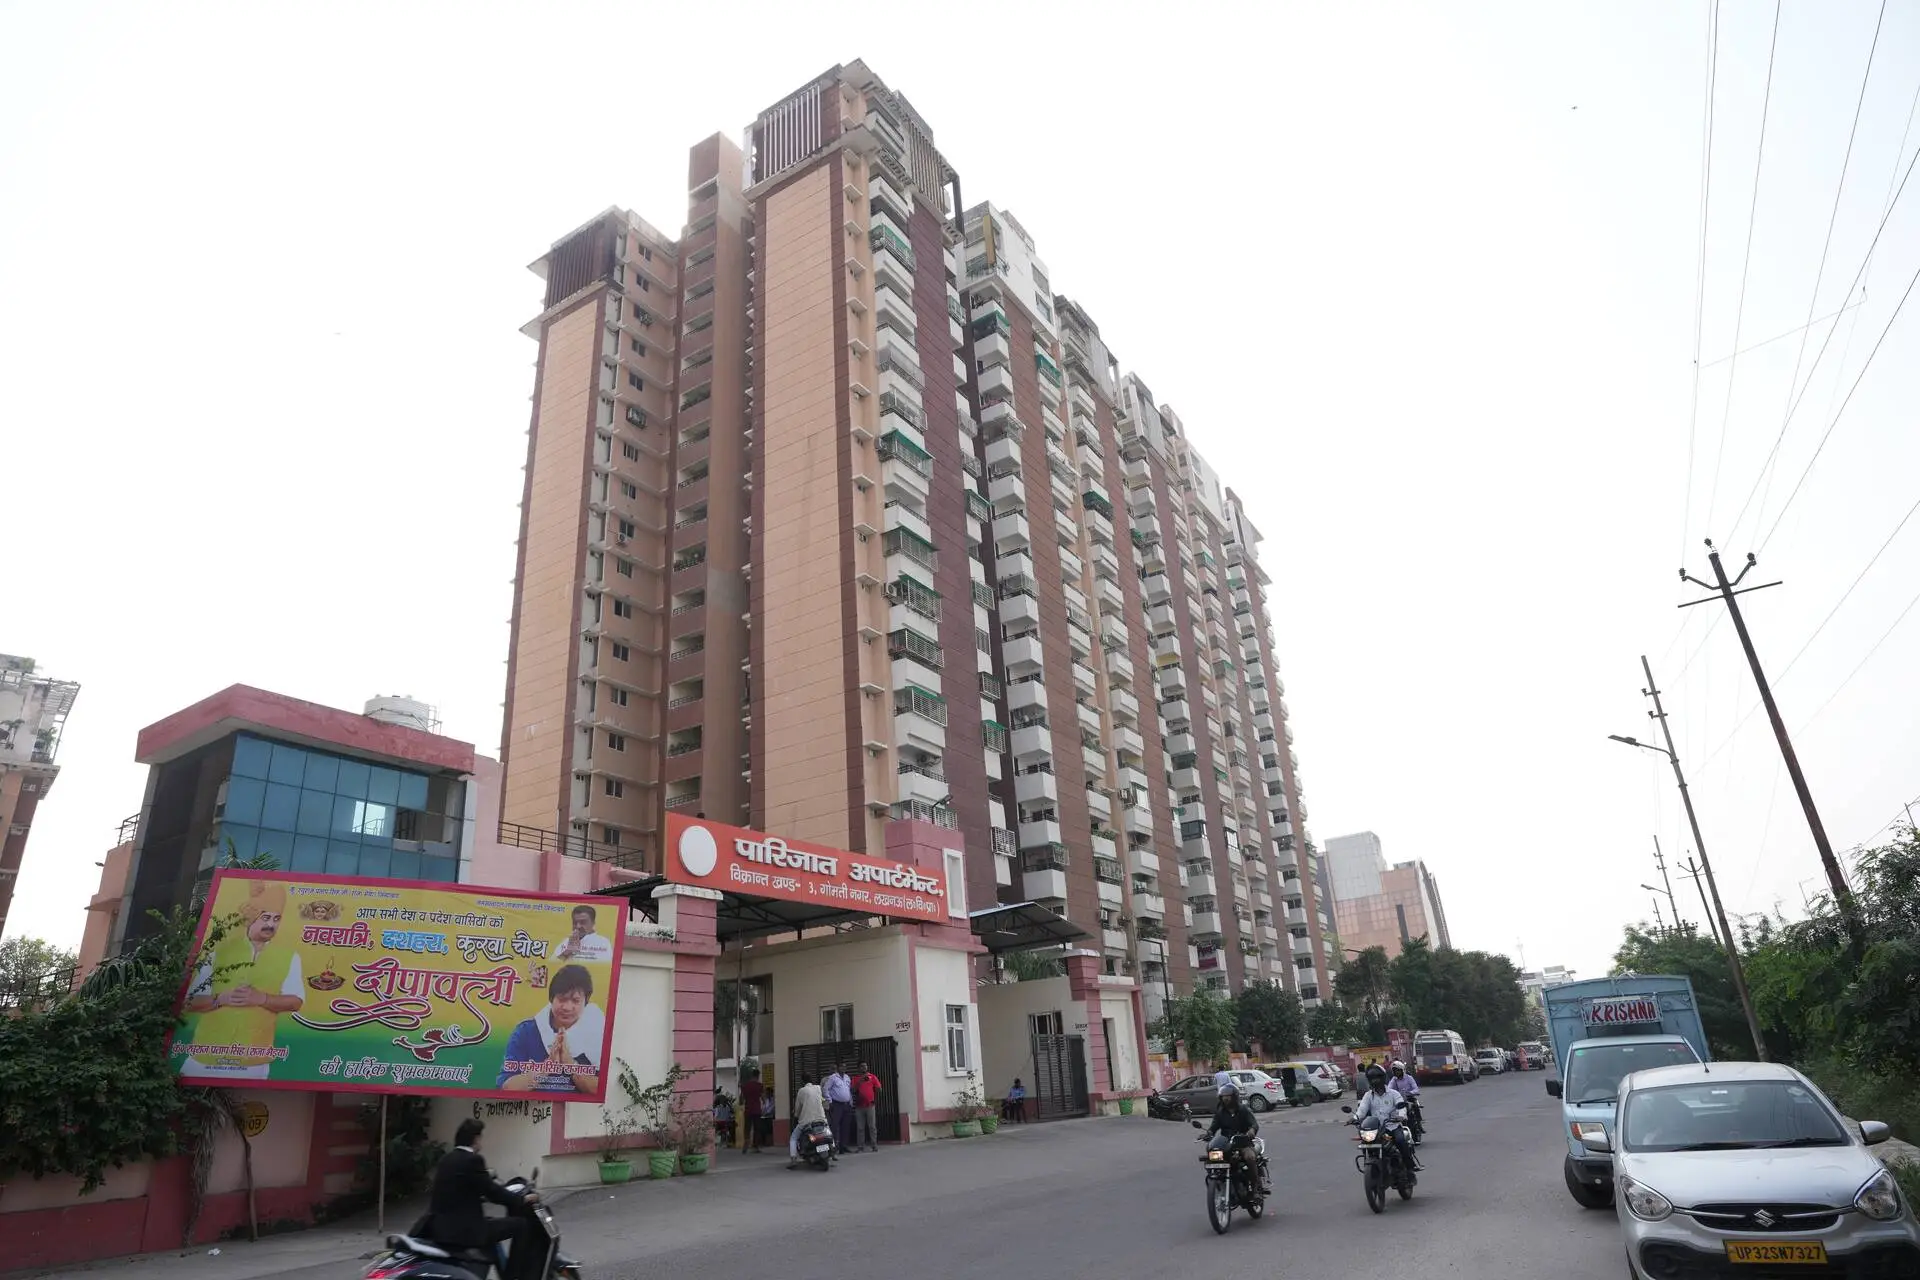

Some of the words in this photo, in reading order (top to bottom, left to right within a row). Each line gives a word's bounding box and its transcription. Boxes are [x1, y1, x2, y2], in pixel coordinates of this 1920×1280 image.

[734, 837, 839, 876] पारिजात
[848, 862, 944, 897] अपार्टमेन्ट,
[729, 863, 769, 887] विक्रान्त
[820, 881, 848, 901] गोमती
[356, 907, 376, 919] आप
[380, 907, 398, 921] सभी
[400, 907, 416, 922] देश
[419, 911, 427, 922] व
[454, 912, 488, 927] वासियों
[489, 915, 505, 929] को
[301, 921, 375, 950] नवरात्रि,
[456, 933, 514, 963] करवा
[511, 928, 549, 959] चौथ
[1591, 1001, 1657, 1023] KRISHNA
[319, 1055, 343, 1076] की
[343, 1056, 389, 1079] हार्दिक
[544, 1058, 564, 1074] सिंह
[532, 1106, 552, 1124] SALE
